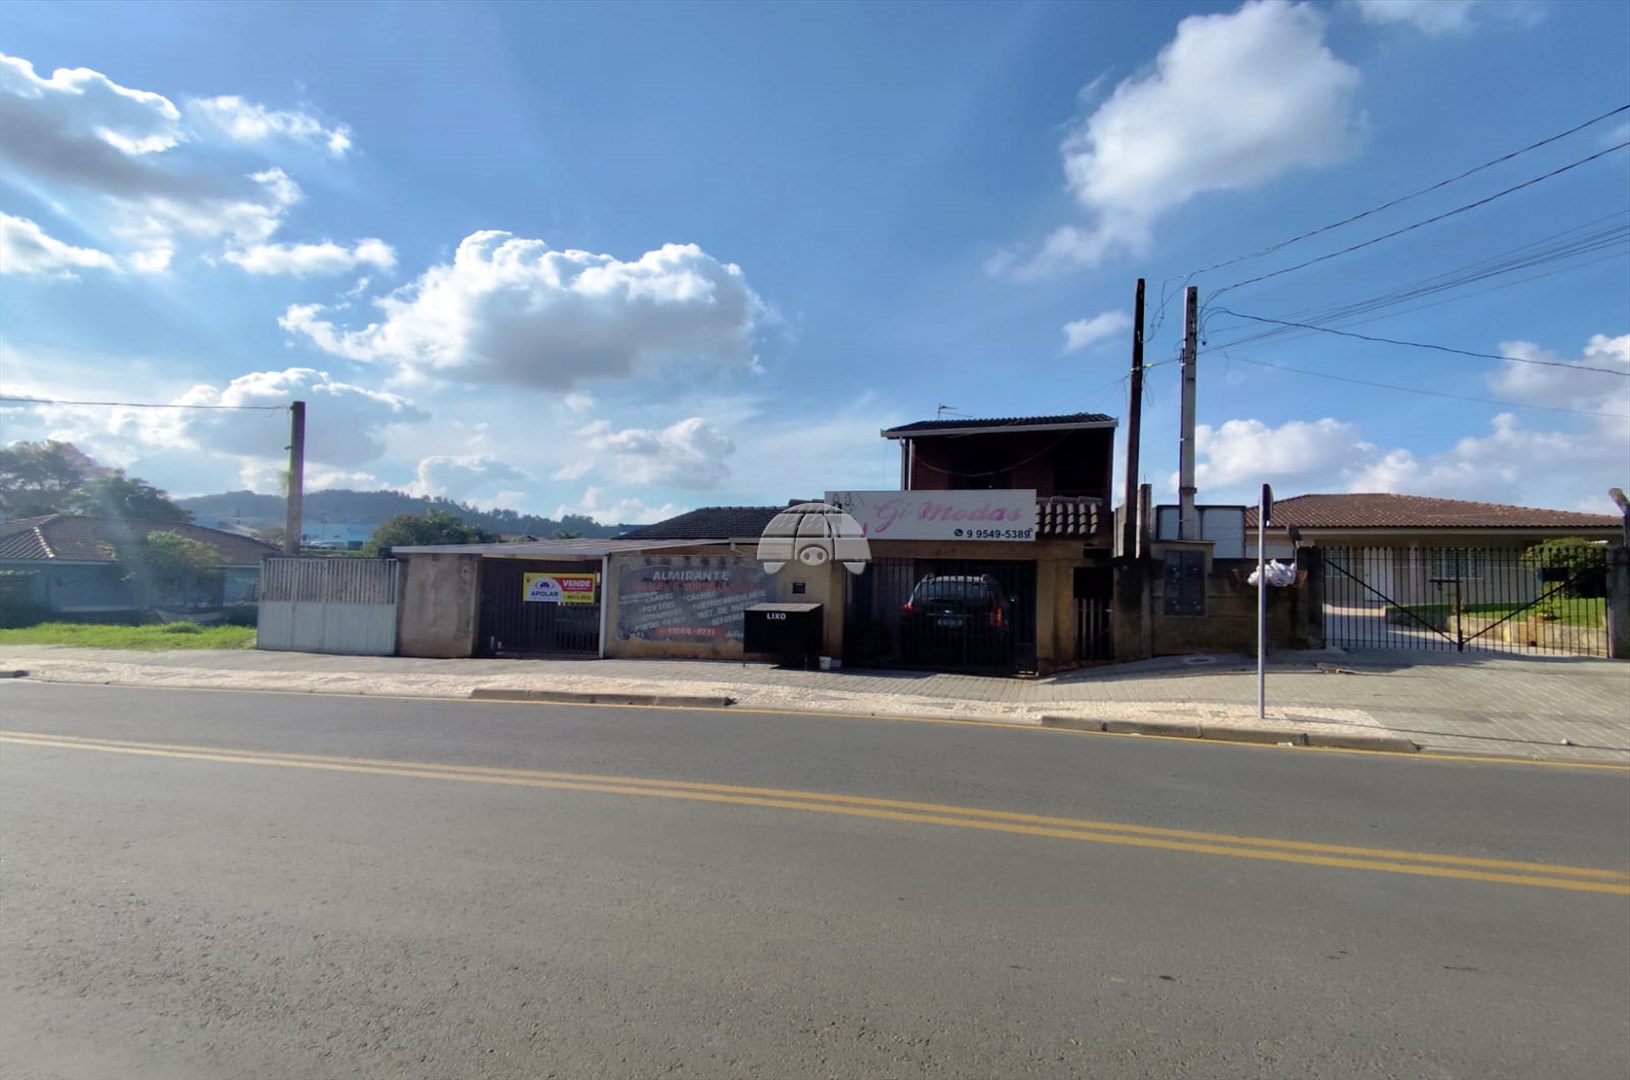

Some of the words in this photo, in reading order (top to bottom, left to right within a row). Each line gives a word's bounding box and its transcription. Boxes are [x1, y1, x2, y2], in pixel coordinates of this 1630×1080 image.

[918, 500, 1023, 522] Modas
[966, 529, 973, 538] 9
[976, 529, 1031, 539] 9549-5389
[653, 570, 731, 582] ALMIRANTE
[562, 579, 592, 588] VENDE
[530, 590, 559, 598] APOLAR
[766, 612, 787, 620] LIXO
